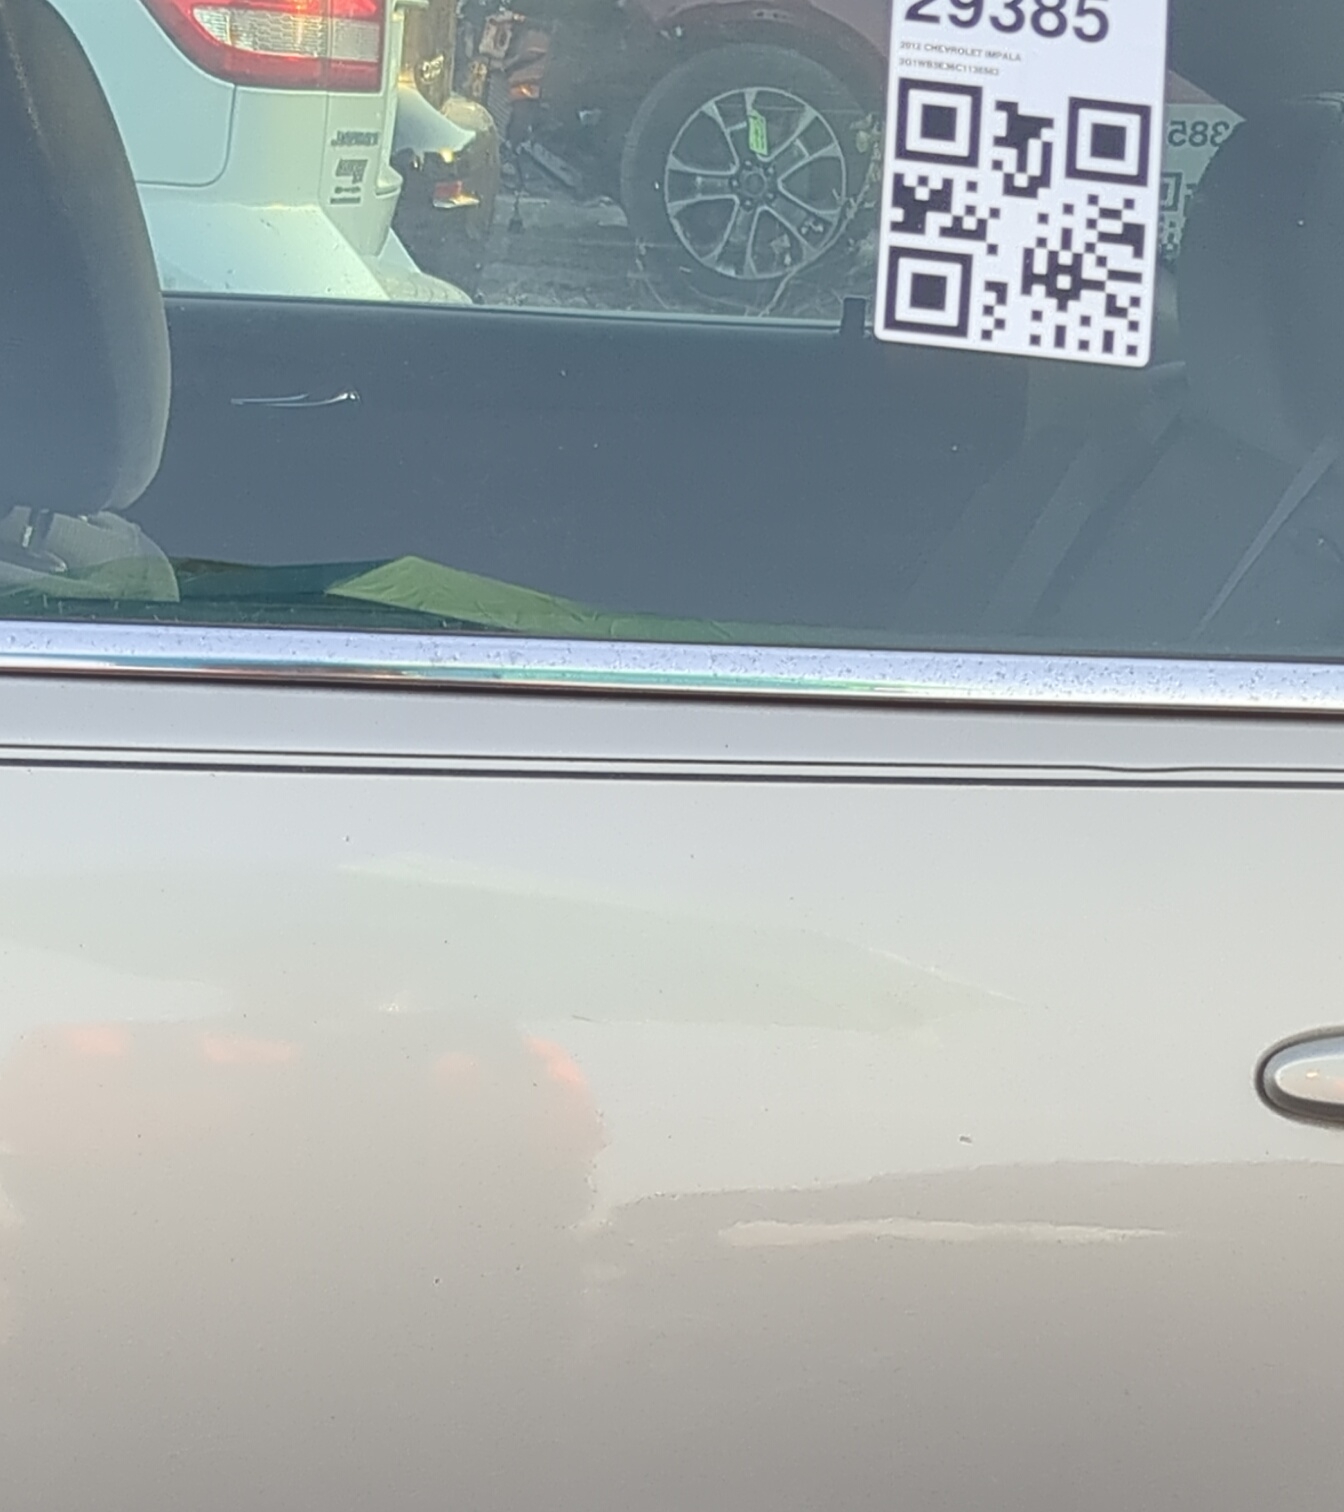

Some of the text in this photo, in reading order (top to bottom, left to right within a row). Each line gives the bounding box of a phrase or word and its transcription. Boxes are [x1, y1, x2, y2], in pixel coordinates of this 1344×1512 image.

[904, 0, 1110, 43] 29385
[899, 41, 1022, 62] 2012 CHEVROLET IMPALA
